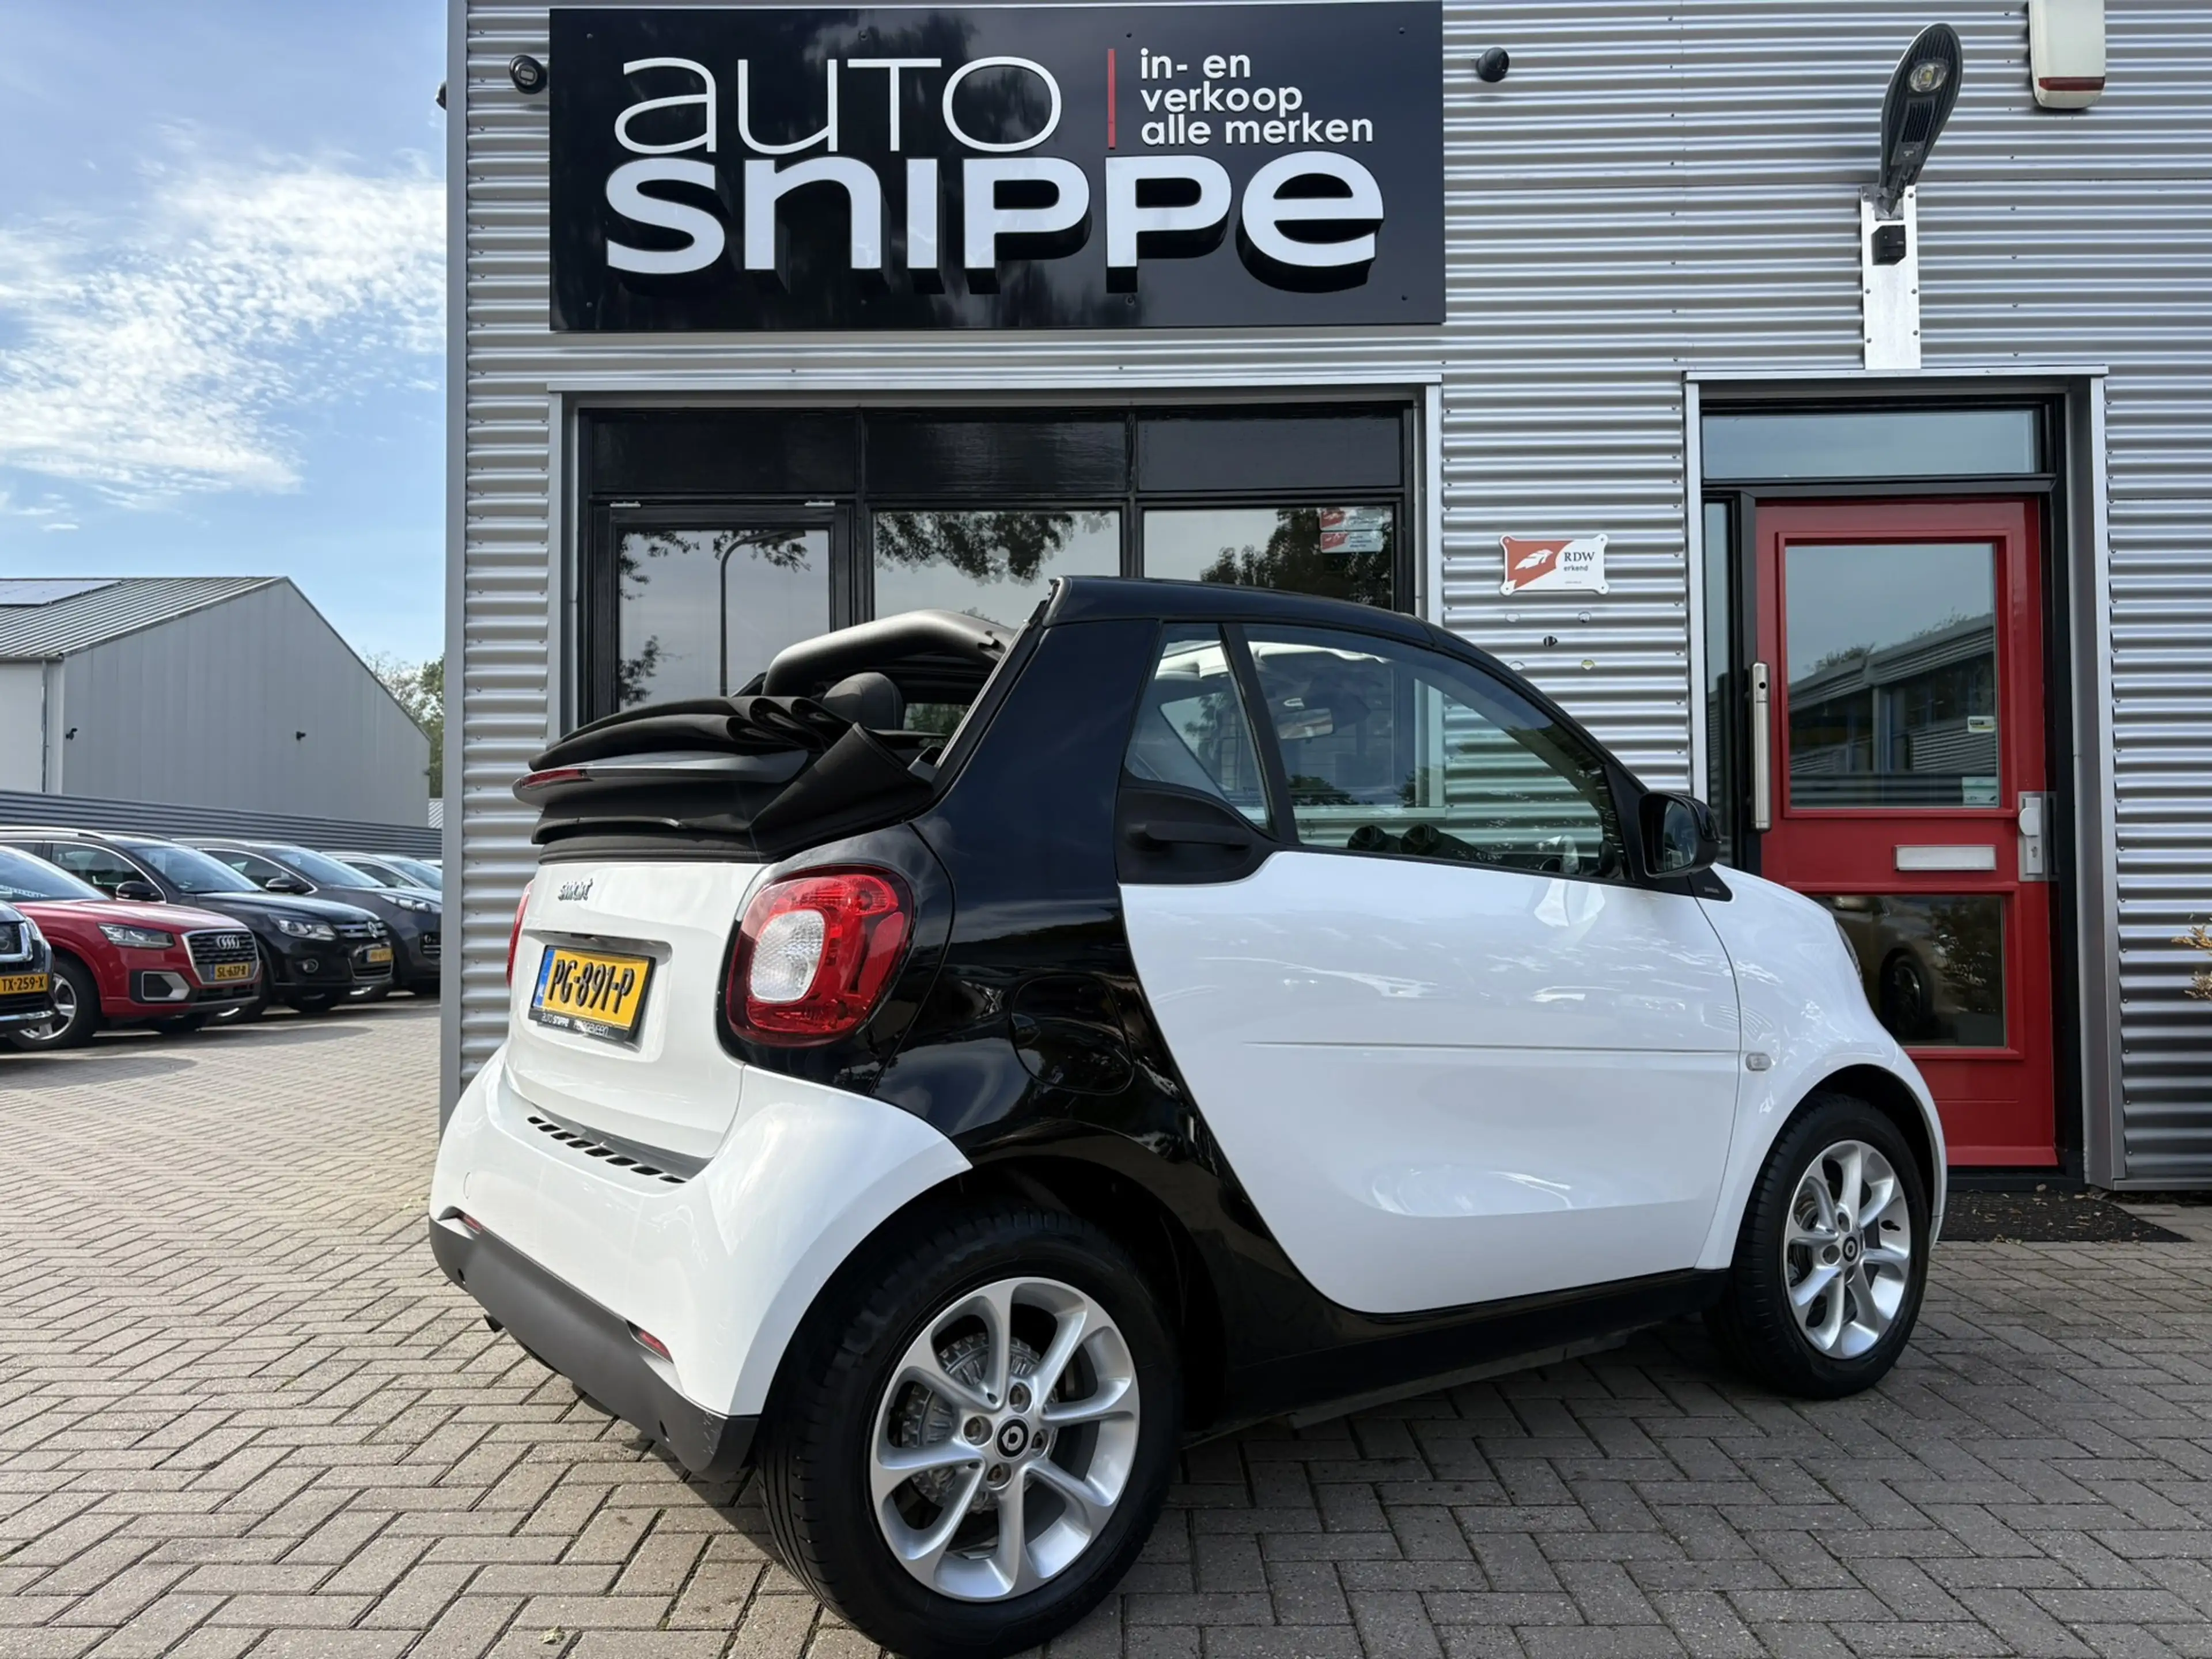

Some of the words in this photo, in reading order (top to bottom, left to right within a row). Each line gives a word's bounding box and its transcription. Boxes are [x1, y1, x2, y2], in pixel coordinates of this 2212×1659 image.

[1140, 48, 1188, 79] in-
[1202, 53, 1251, 79] en
[1140, 81, 1303, 118] verkoop
[1141, 113, 1212, 146] alle
[1225, 112, 1373, 145] merken
[1564, 552, 1595, 562] RDW
[2, 976, 44, 991] TX-259-X
[548, 959, 635, 1014] PG-891-P
